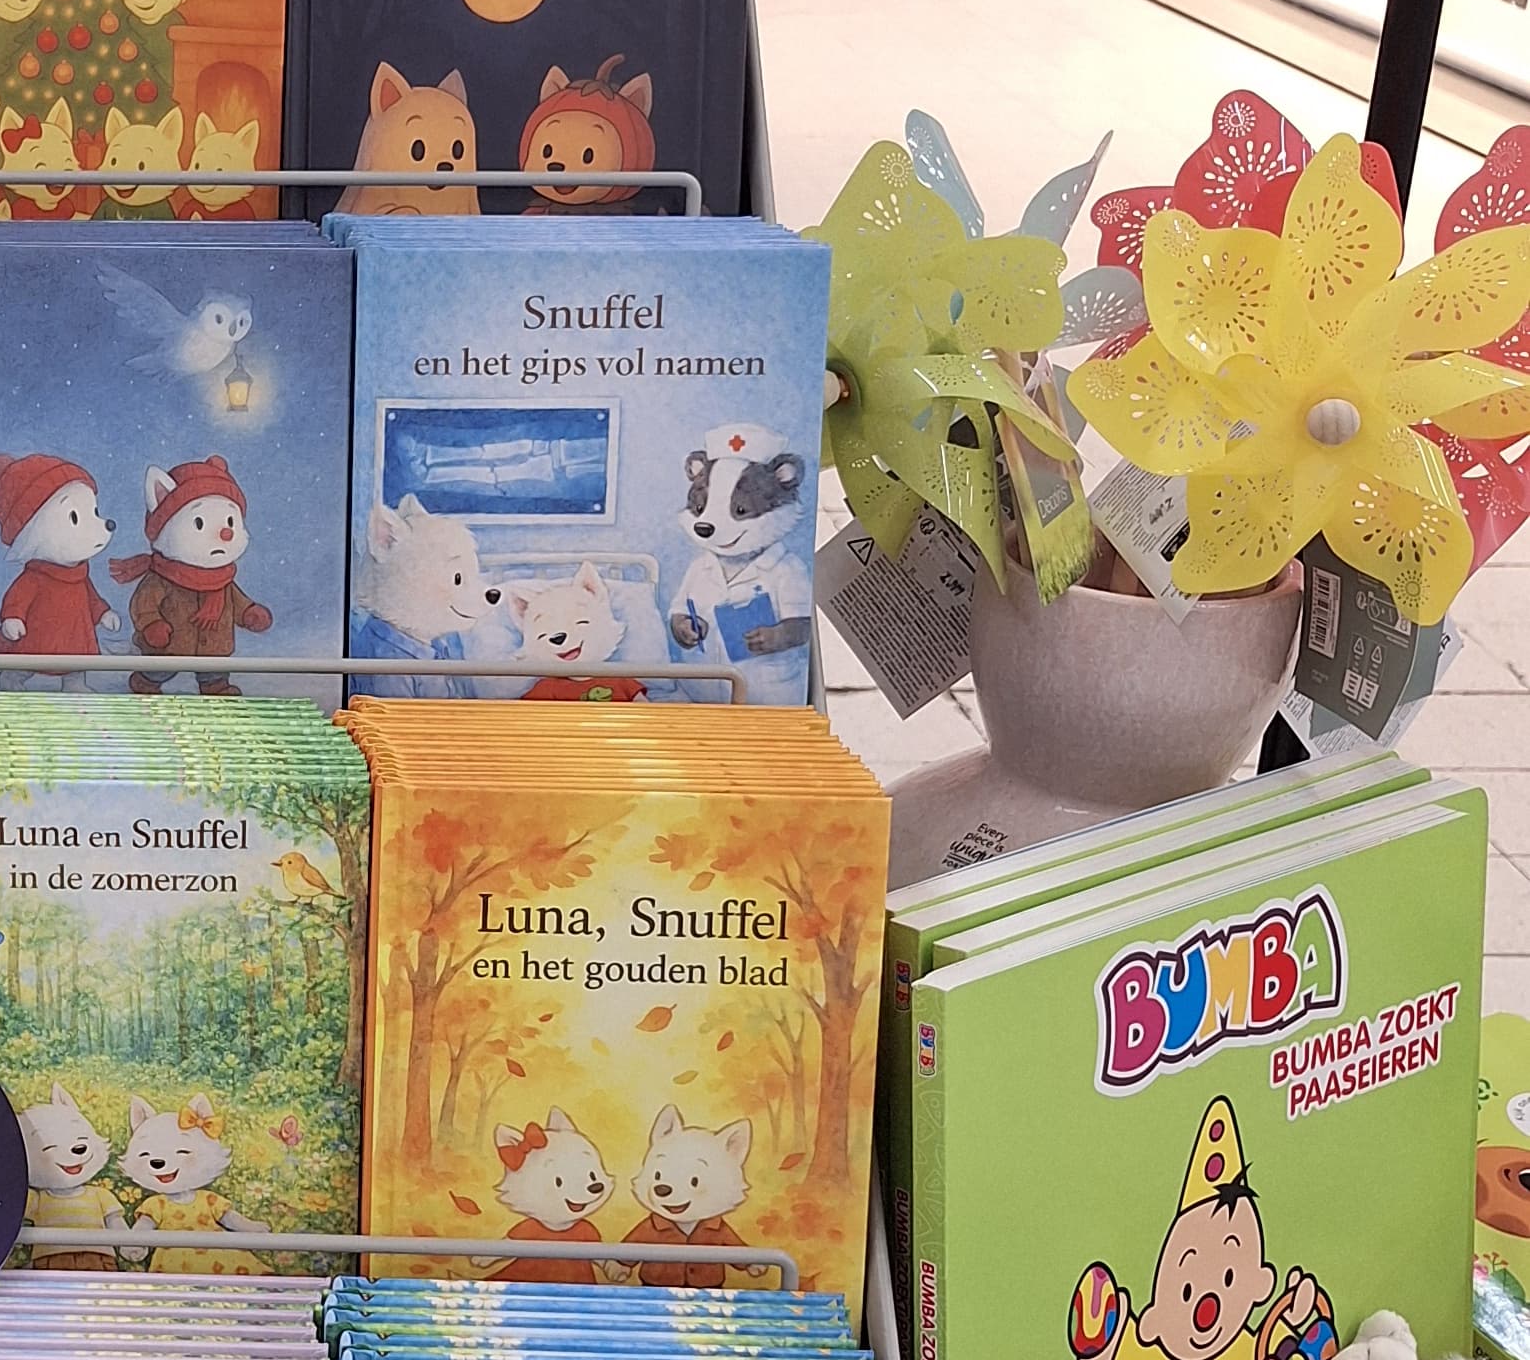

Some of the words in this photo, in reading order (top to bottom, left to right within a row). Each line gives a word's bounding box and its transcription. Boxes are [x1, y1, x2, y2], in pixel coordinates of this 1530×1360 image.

[522, 294, 665, 331] Snuffel
[414, 357, 451, 378] en
[461, 348, 513, 378] het
[521, 348, 587, 386] gips
[596, 349, 645, 378] vol
[655, 356, 766, 378] namen
[88, 830, 122, 850] en
[131, 817, 249, 850] Snuffel
[964, 832, 994, 848] piece
[994, 842, 1005, 853] is
[977, 823, 1008, 842] Every
[9, 864, 39, 891] in
[46, 862, 83, 891] de
[91, 870, 239, 893] zomerzon
[477, 894, 606, 942] Luna,
[629, 894, 789, 941] Snuffel
[473, 959, 510, 982] en
[520, 952, 574, 982] het
[585, 955, 709, 992] gouden
[718, 956, 789, 987] blad
[1104, 896, 1341, 1084] BUMBA
[1273, 1021, 1371, 1085] BUMBA
[1380, 986, 1460, 1043] ZOEKT
[1289, 1033, 1440, 1118] PAASEIEREN
[918, 1260, 936, 1331] BUMBA
